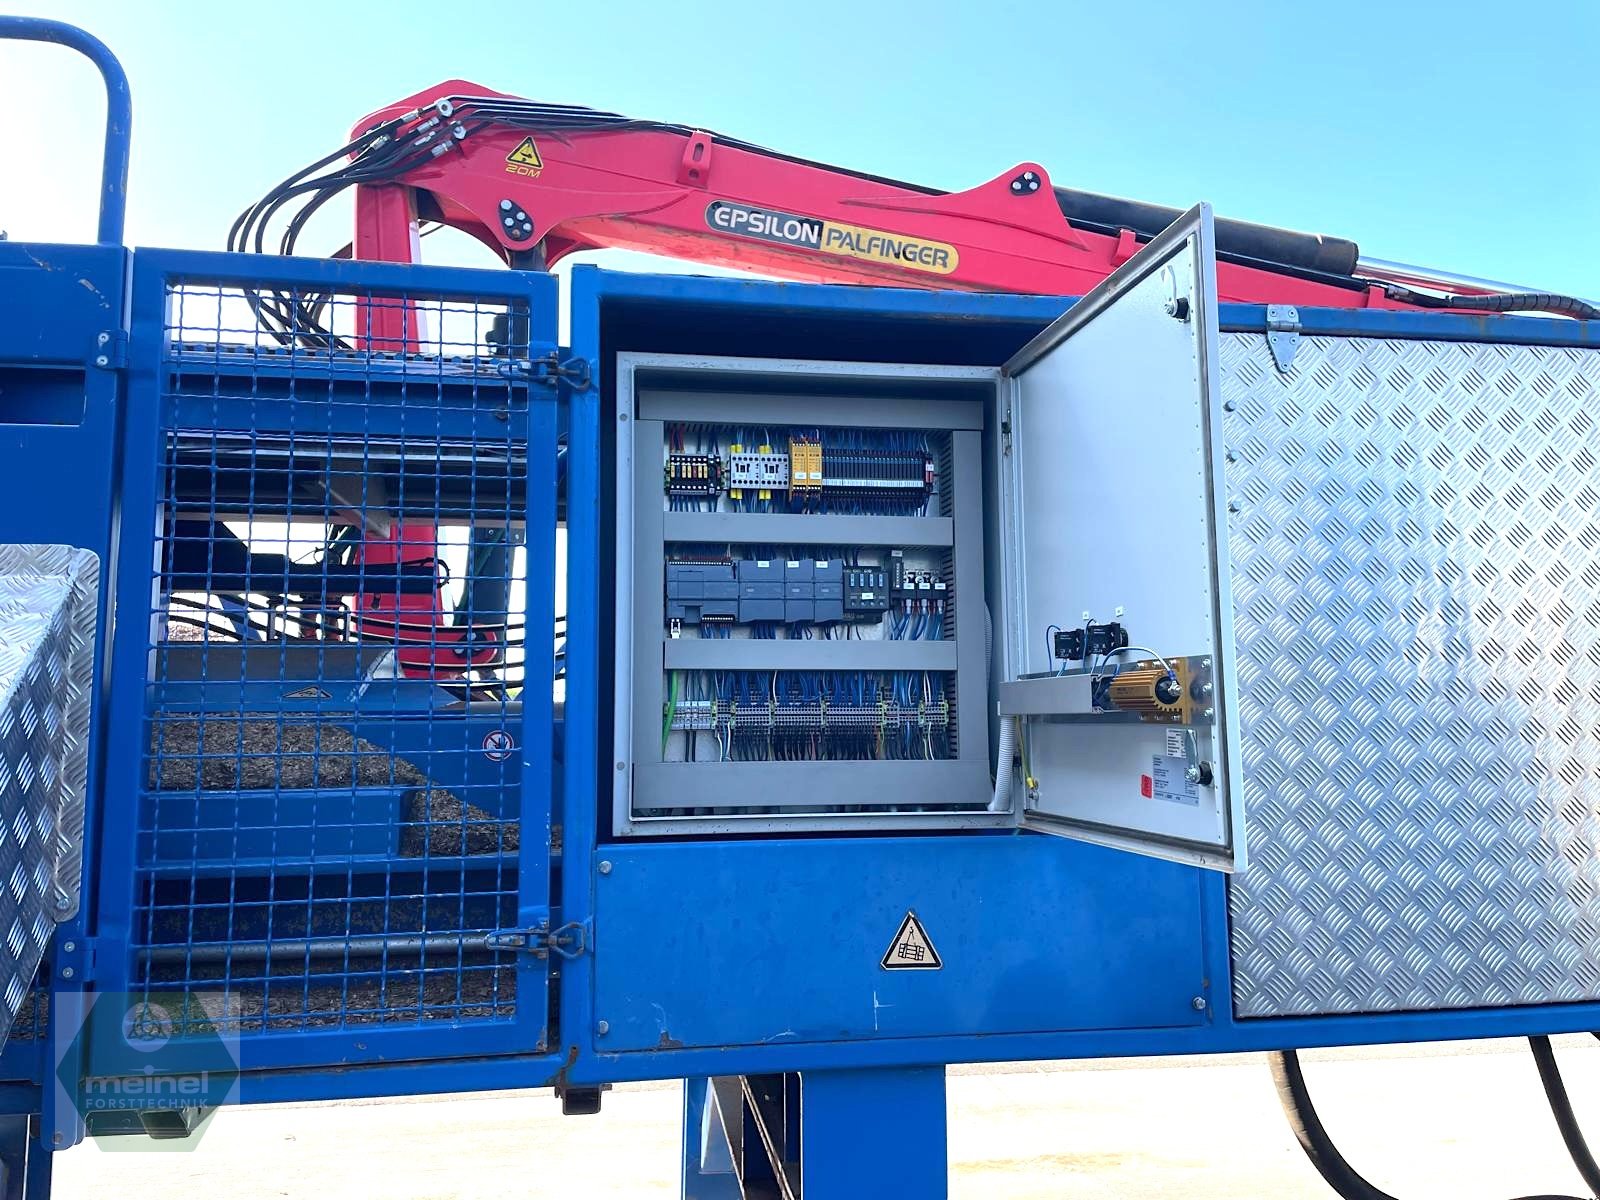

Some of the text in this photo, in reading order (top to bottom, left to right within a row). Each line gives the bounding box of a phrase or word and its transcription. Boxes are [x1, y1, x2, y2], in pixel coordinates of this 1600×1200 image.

[505, 164, 541, 178] 20M
[714, 206, 949, 269] EPSILON PALFINGER
